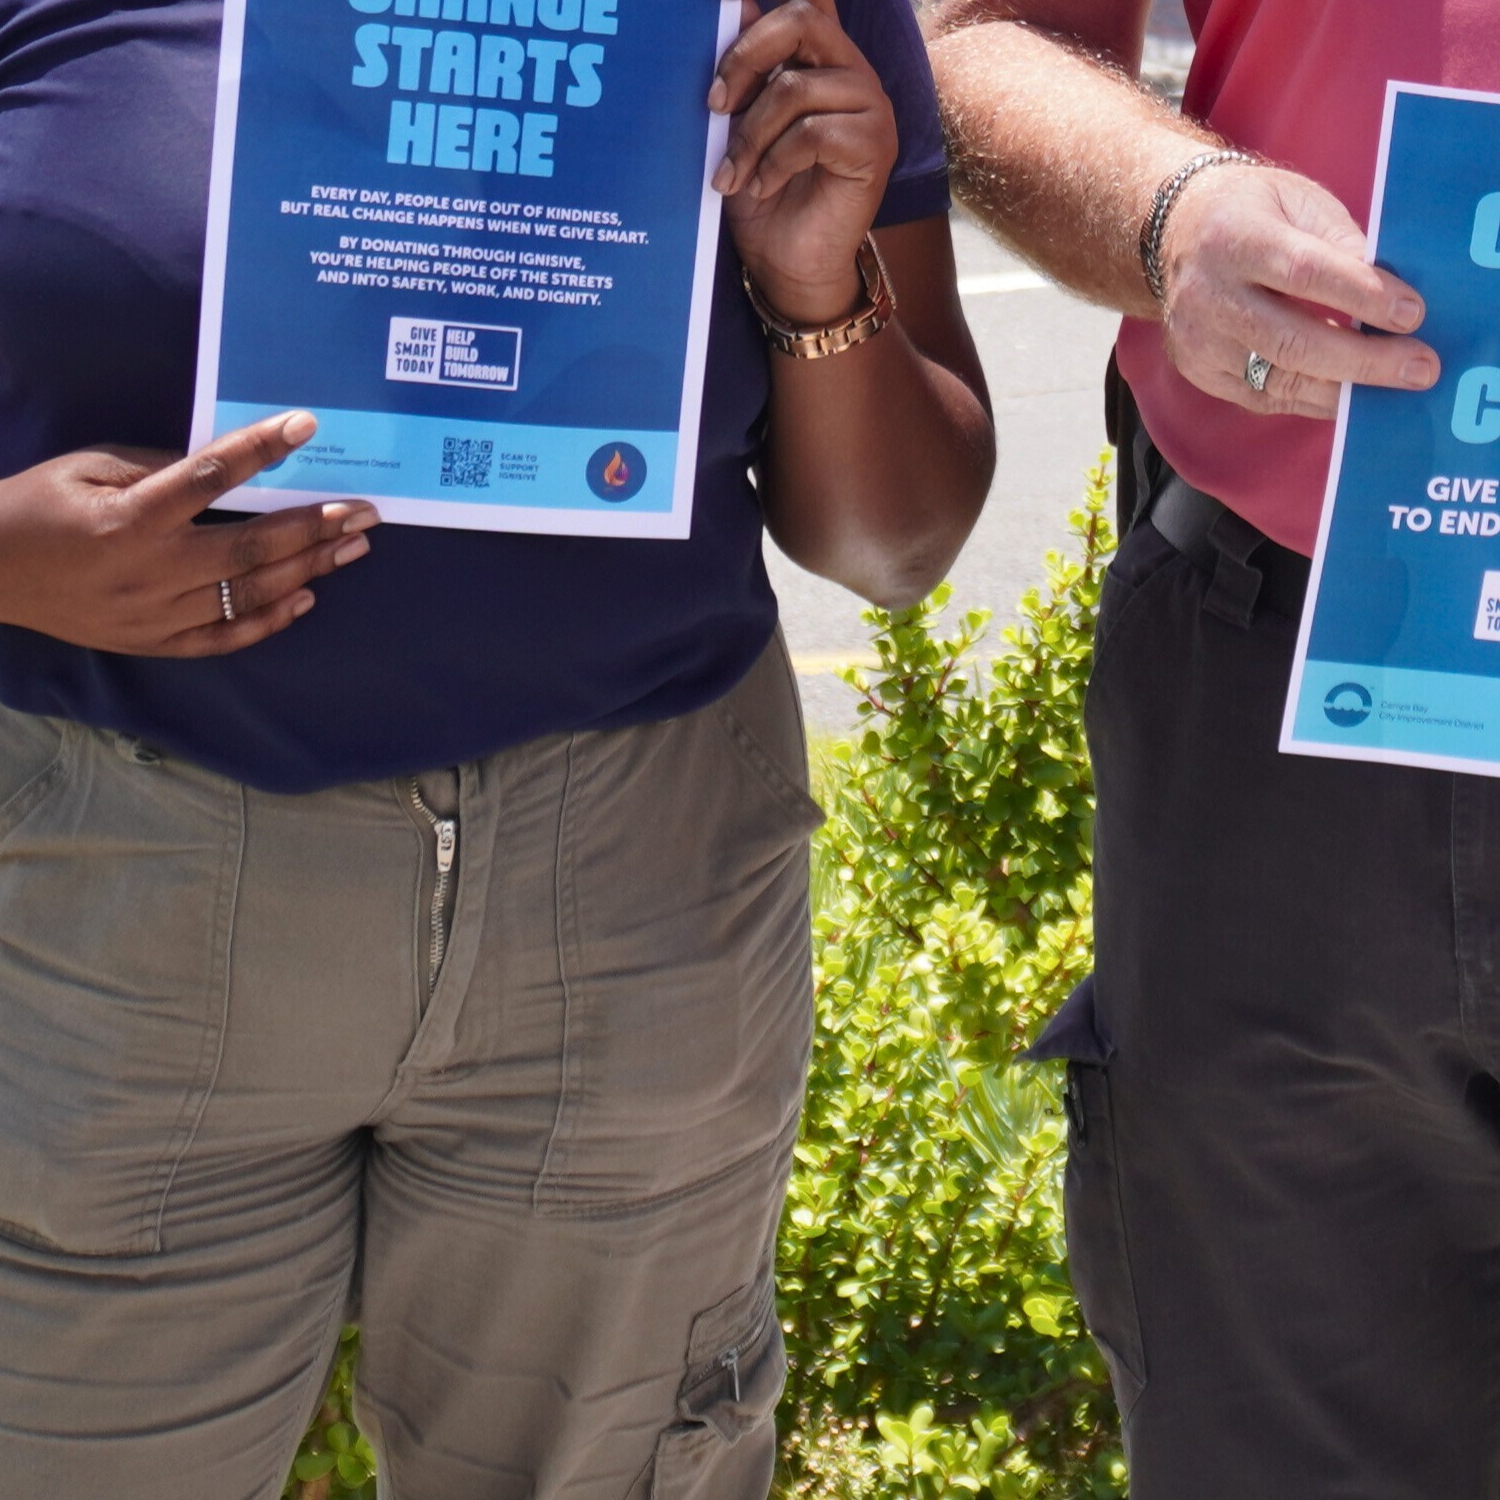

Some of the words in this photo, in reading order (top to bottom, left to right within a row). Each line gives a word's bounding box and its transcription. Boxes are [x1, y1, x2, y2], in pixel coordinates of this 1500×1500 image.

[351, 24, 604, 107] STARTS
[386, 101, 557, 177] HERE
[311, 185, 357, 201] EVERY
[360, 190, 392, 205] DAY,
[395, 193, 449, 210] PEOPLE
[452, 198, 487, 213] GIVE
[489, 201, 521, 216] OUT
[523, 204, 544, 218] OF
[546, 207, 622, 227] KINDNESS,
[280, 201, 311, 215] BUT
[313, 203, 349, 219] REAL
[352, 207, 414, 224] CHANGE
[417, 212, 484, 231] HAPPENS
[487, 219, 531, 235] WHEN
[534, 223, 556, 237] WE
[559, 226, 594, 241] GIVE
[597, 229, 649, 245] SMART.
[339, 236, 359, 249] BY
[361, 238, 439, 257] DONATING
[442, 245, 515, 263] THROUGH
[519, 252, 586, 271] IGNISIVE,
[317, 270, 349, 284] AND
[352, 273, 389, 287] INTO
[392, 276, 448, 295] SAFETY,
[451, 281, 500, 299] WORK,
[503, 286, 534, 300] AND
[366, 255, 430, 273] HELPING
[433, 261, 487, 279] PEOPLE
[490, 267, 518, 281] OFF
[520, 269, 548, 285] THE
[551, 272, 613, 289] STREETS
[410, 326, 437, 342] GIVE
[446, 329, 476, 345] HELP
[395, 342, 436, 358] SMART
[445, 345, 479, 362] BUILD
[397, 358, 435, 374] TODAY
[444, 362, 509, 382] TOMORROW
[499, 463, 539, 472] SUPPORT
[500, 453, 523, 462] SCAN
[526, 454, 538, 462] TO
[1427, 476, 1499, 504] GIVE
[1388, 505, 1432, 532] TO
